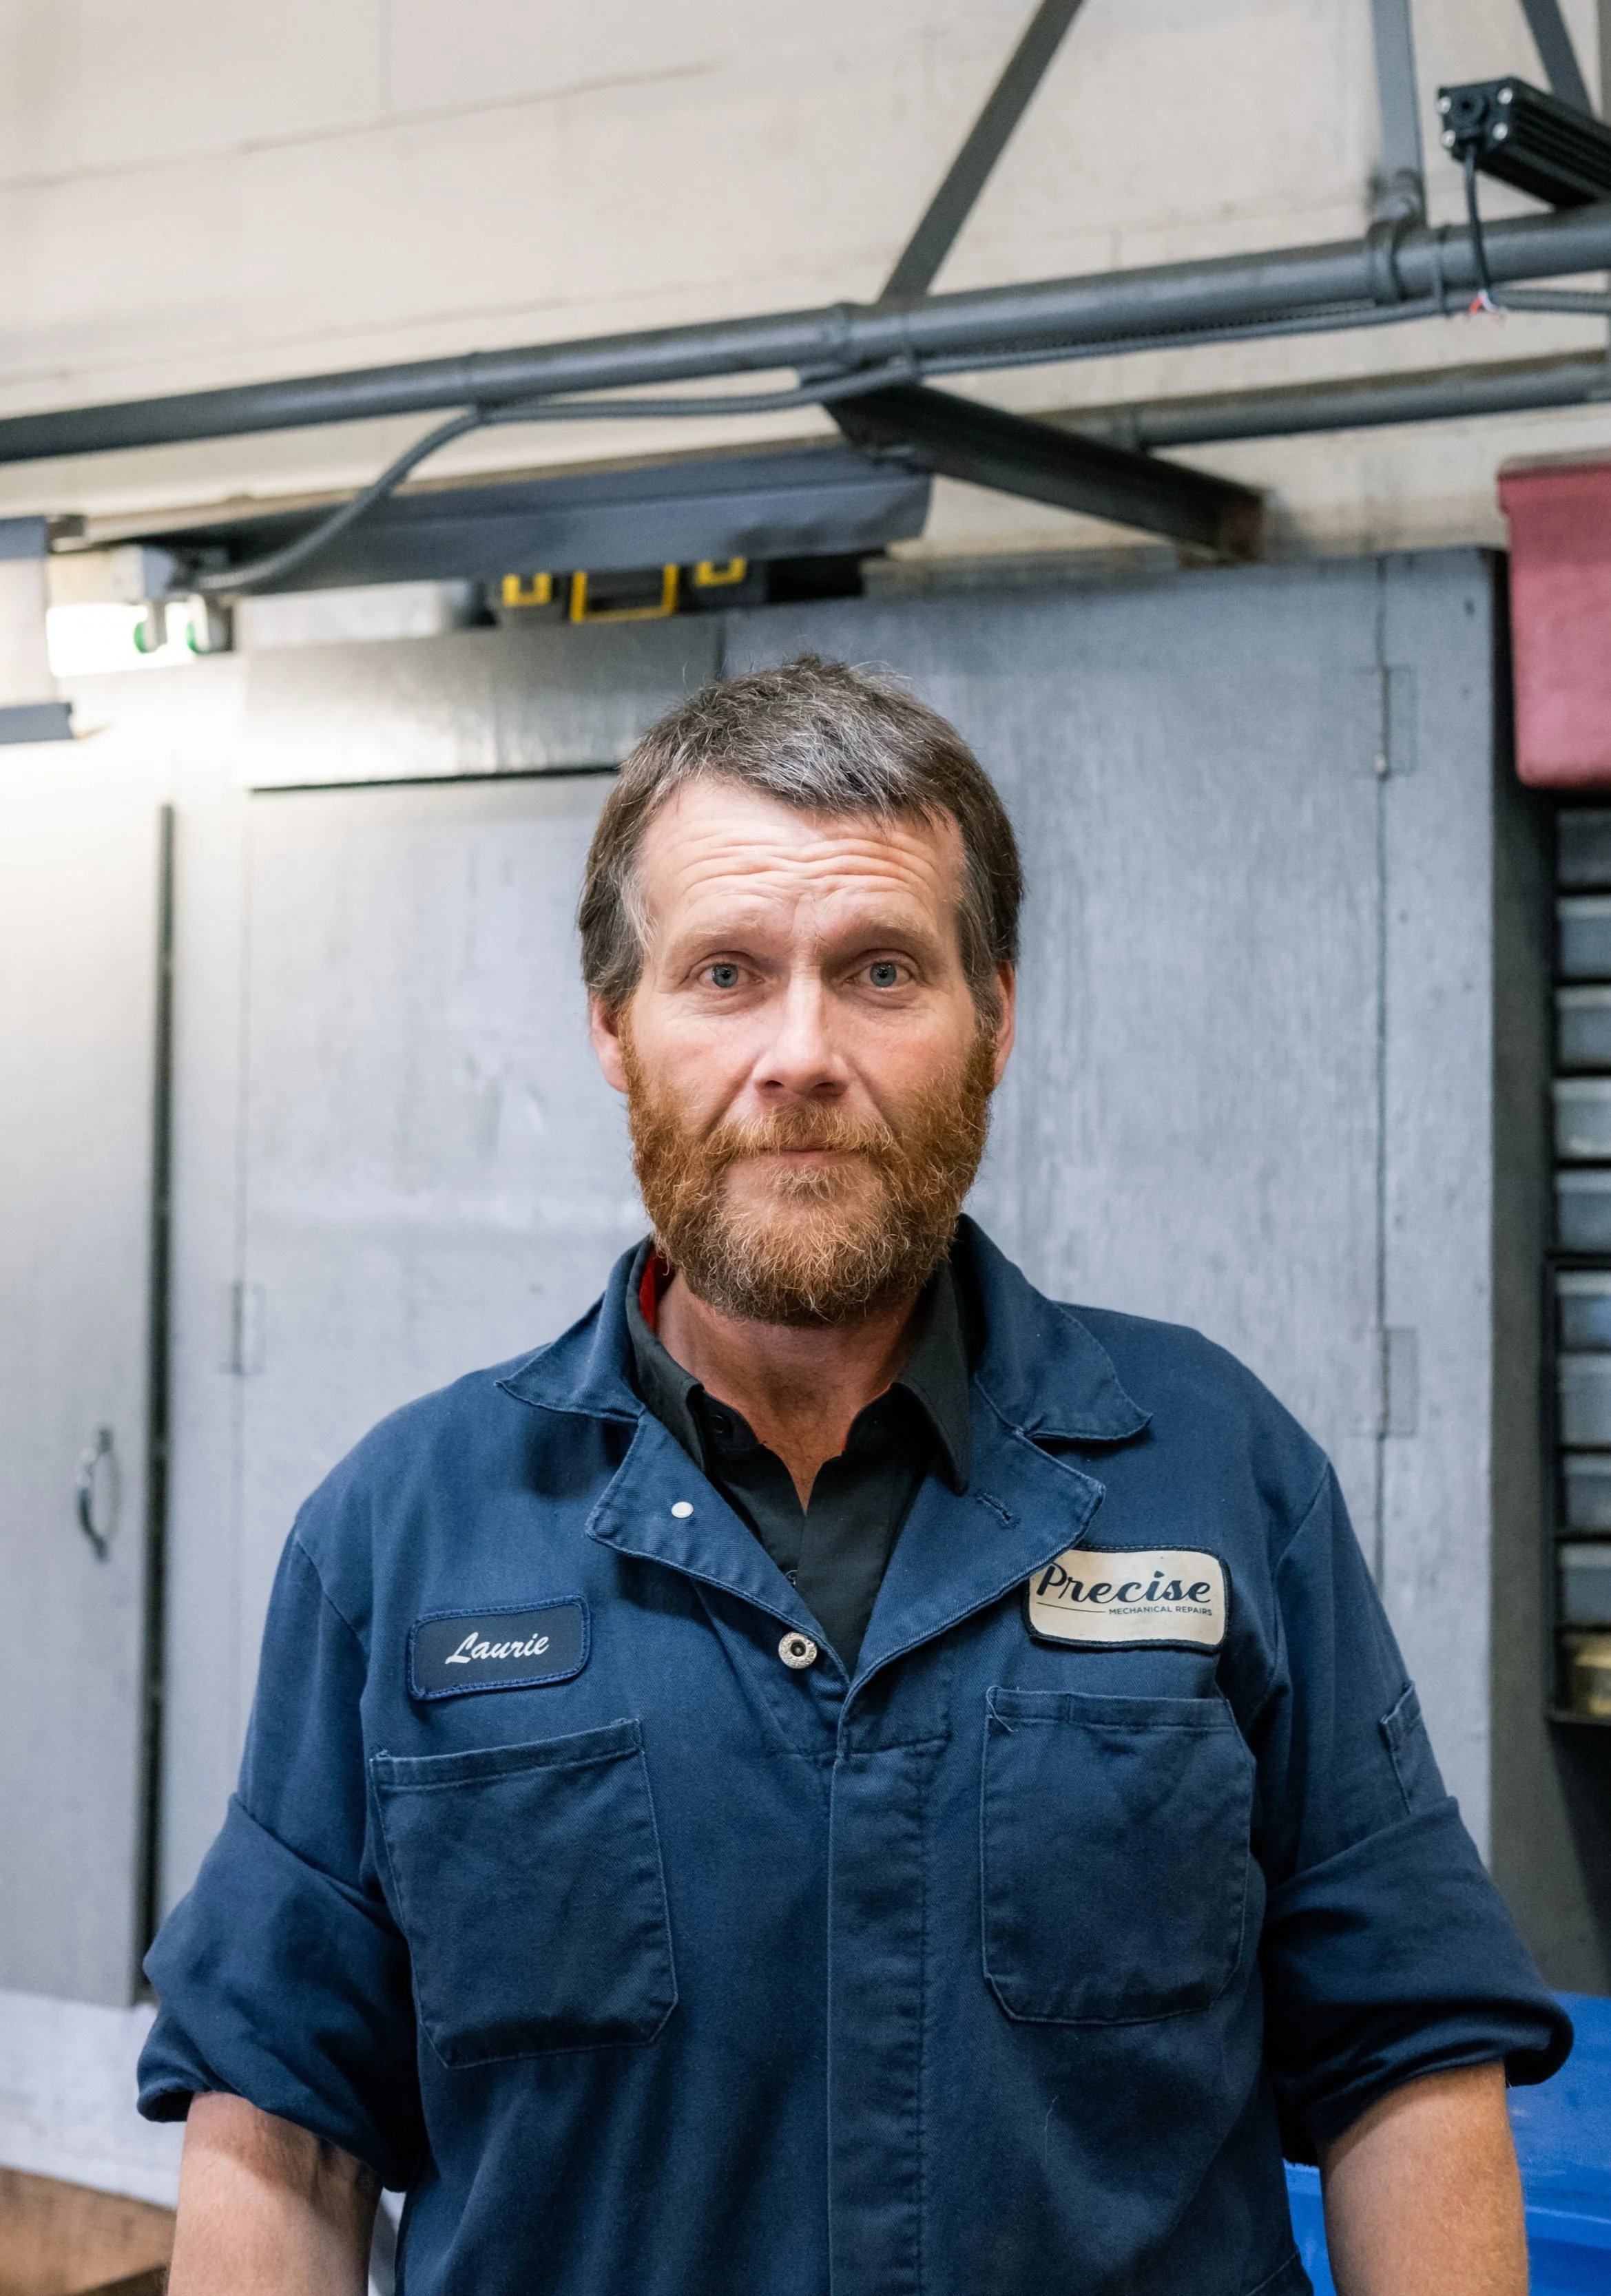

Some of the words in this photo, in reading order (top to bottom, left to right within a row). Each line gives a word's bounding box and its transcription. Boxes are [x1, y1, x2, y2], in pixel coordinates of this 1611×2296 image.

[1036, 1561, 1212, 1604] Precise
[1109, 1605, 1173, 1616] MECHANICAL
[1175, 1605, 1213, 1616] REPAIRS
[444, 1631, 550, 1664] Laurie
